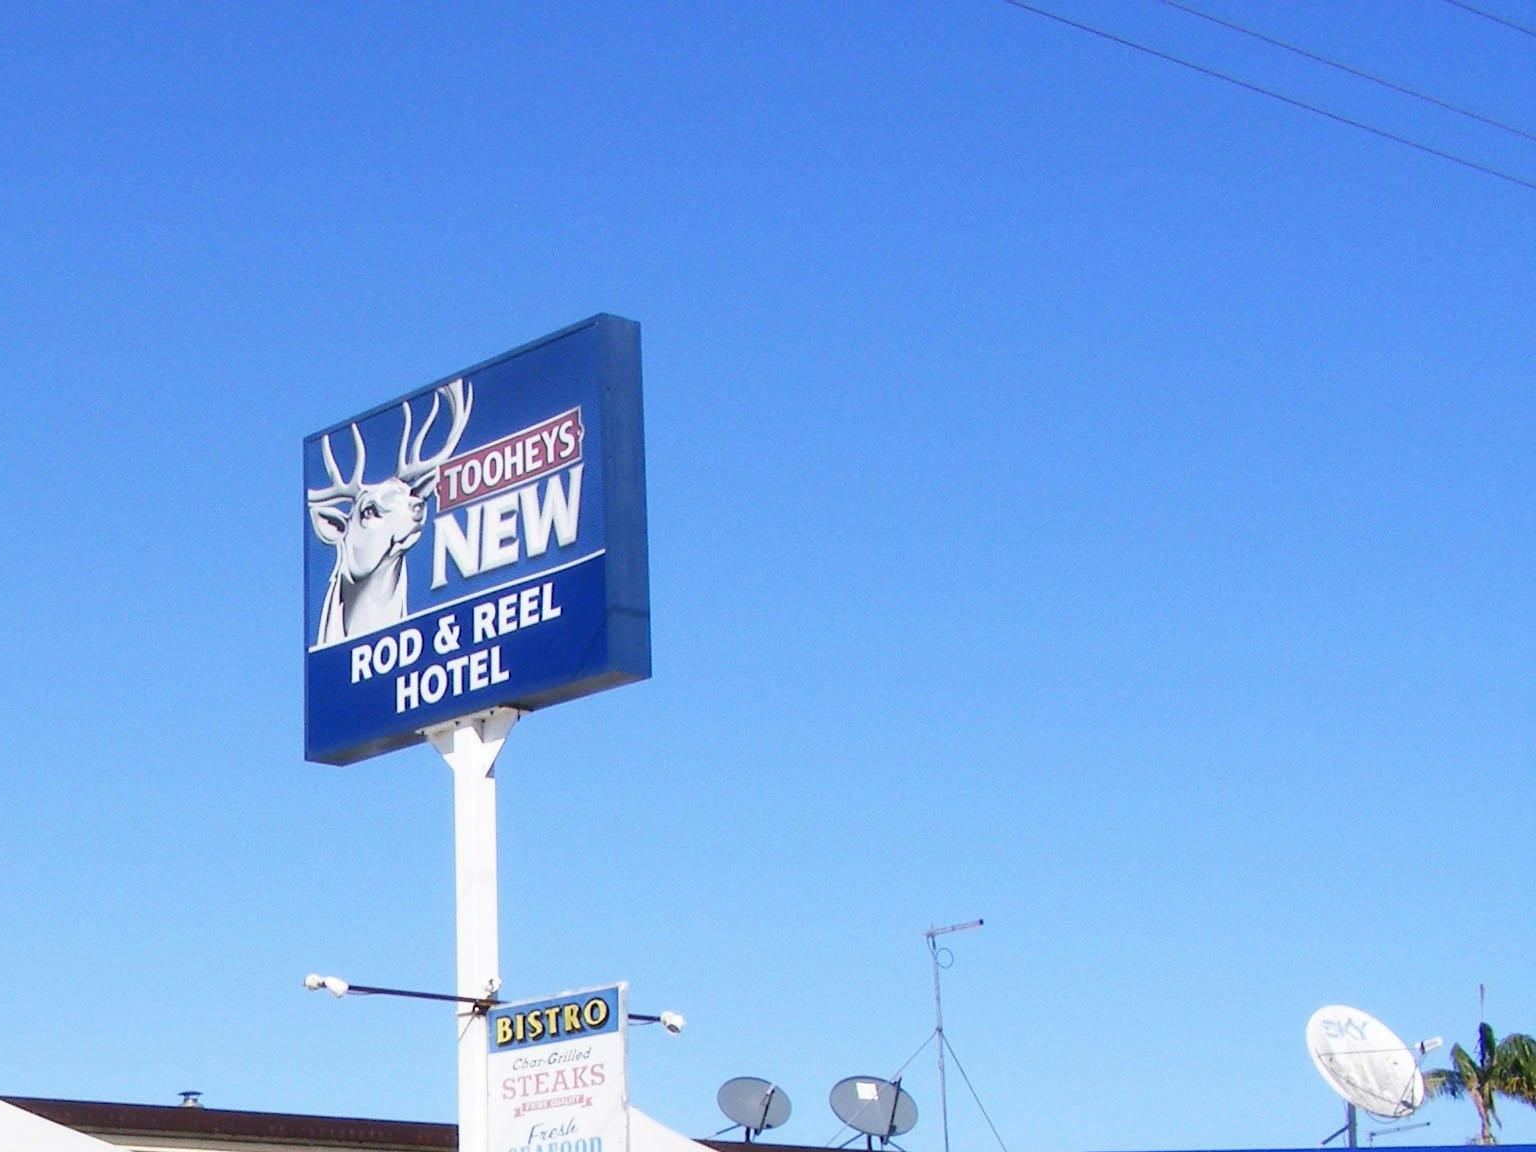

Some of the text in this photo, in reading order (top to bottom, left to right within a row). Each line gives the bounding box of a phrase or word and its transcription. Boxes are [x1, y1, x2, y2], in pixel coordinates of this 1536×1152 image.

[443, 418, 576, 501] TOOHEYS
[430, 463, 585, 590] NEW
[351, 582, 562, 684] ROD & REEL
[396, 645, 510, 713] HOTEL
[496, 997, 609, 1047] BISTRO
[502, 1063, 606, 1100] STEAKS
[512, 1047, 592, 1071] Char-Grilled
[527, 1116, 579, 1145] Fresh
